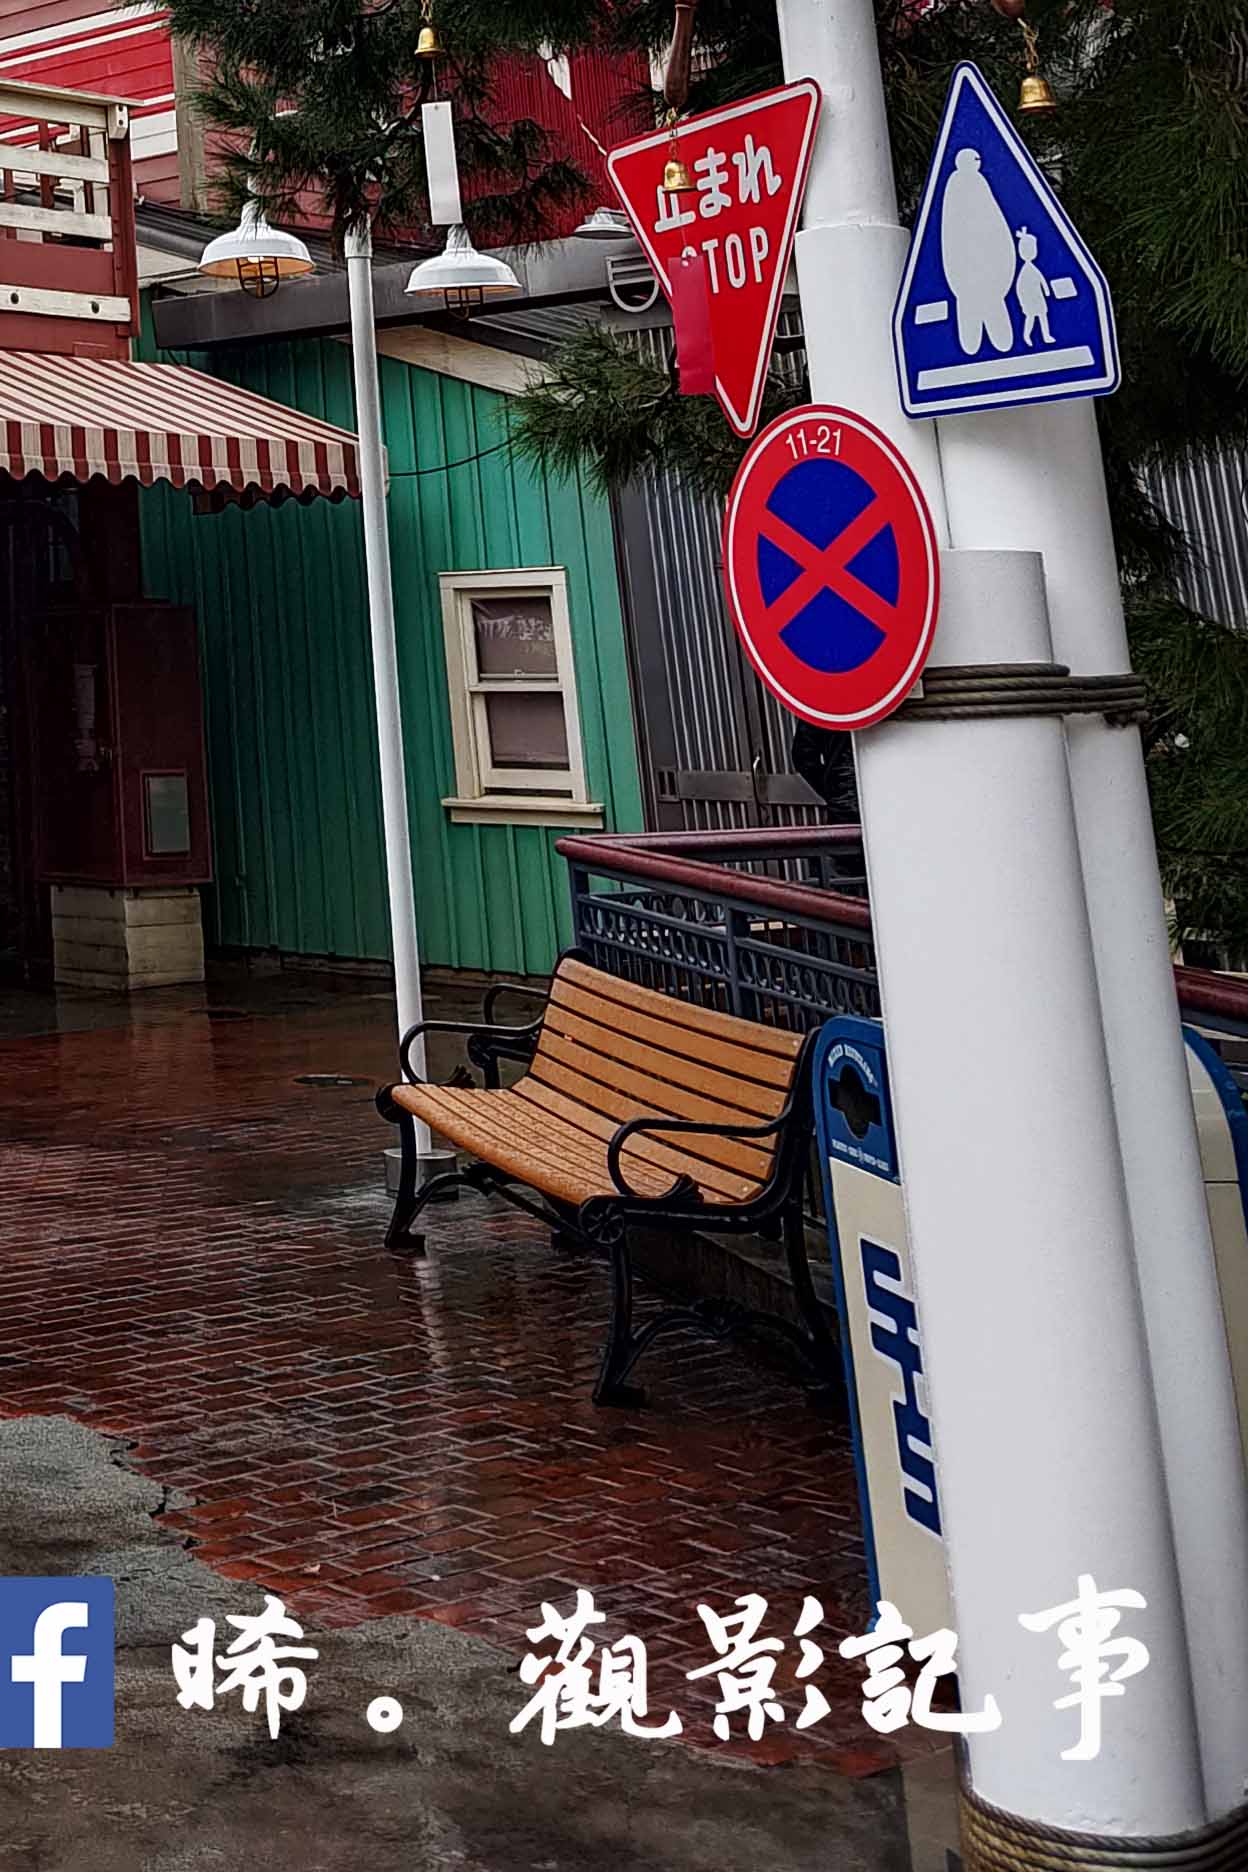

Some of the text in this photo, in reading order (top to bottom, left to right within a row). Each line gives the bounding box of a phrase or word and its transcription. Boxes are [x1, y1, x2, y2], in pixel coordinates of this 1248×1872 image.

[654, 133, 782, 233] 止まれ
[785, 425, 841, 459] 11-21
